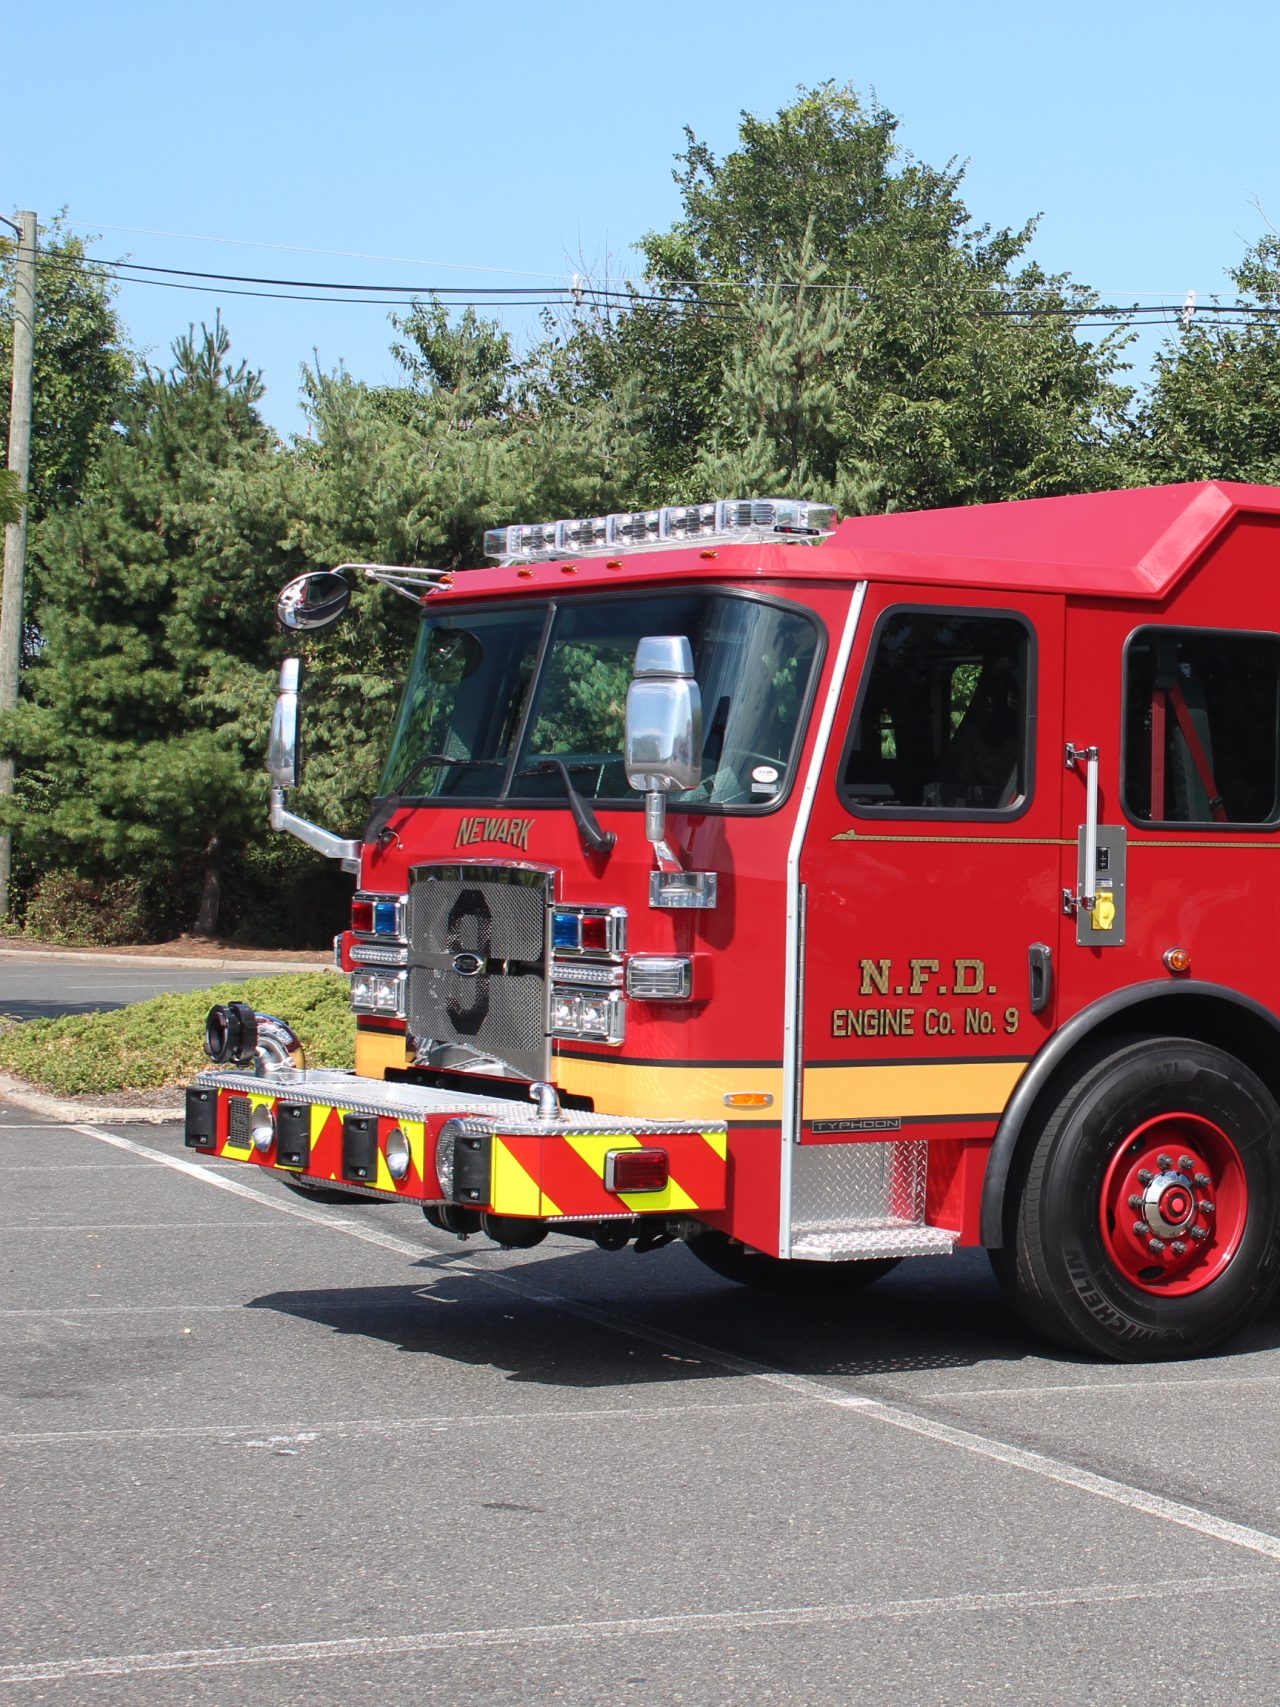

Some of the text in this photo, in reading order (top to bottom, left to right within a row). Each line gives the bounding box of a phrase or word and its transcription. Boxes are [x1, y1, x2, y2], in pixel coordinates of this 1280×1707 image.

[454, 817, 536, 851] NEWARK
[859, 959, 997, 995] N.F.D.
[832, 1008, 915, 1038] ENGINE
[1004, 1007, 1020, 1033] 9
[814, 1119, 899, 1131] TYPHOON
